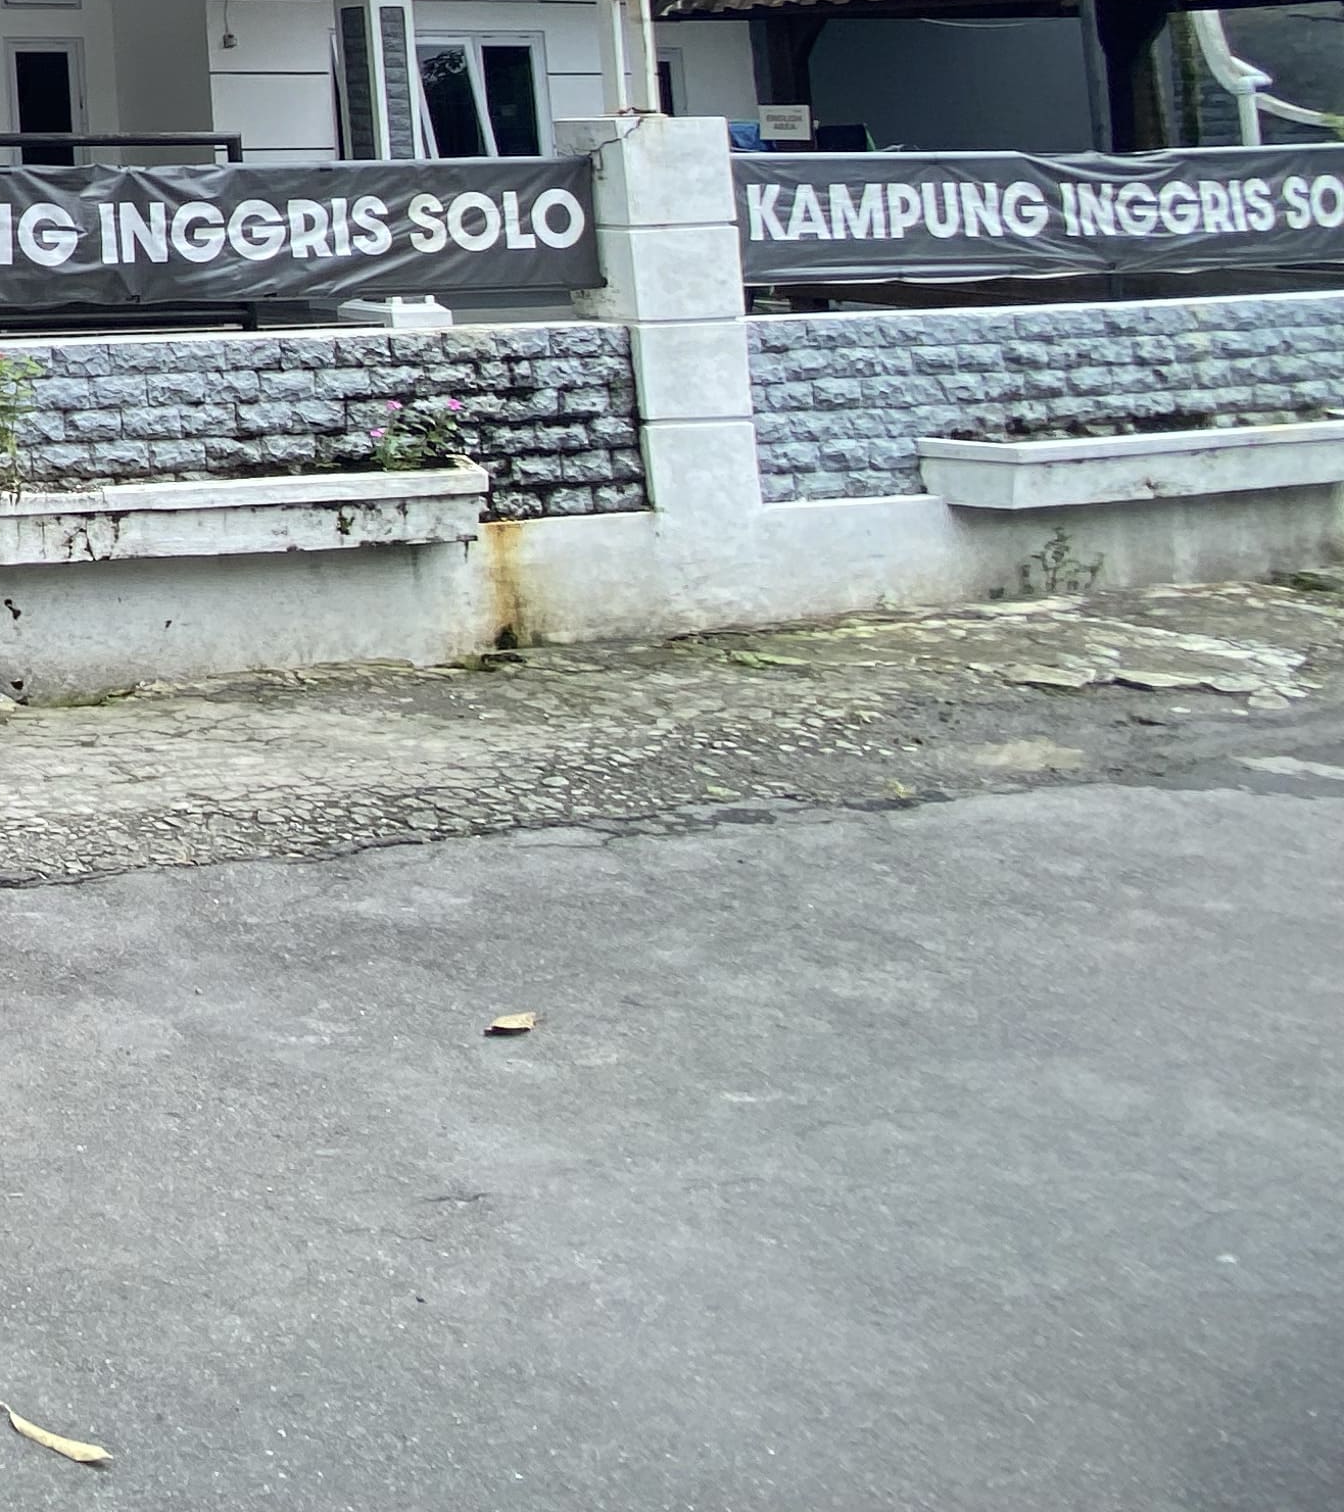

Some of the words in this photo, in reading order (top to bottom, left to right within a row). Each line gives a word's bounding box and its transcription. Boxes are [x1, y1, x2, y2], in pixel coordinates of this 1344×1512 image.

[97, 194, 393, 265] INGGRIS
[407, 188, 585, 253] SOLO
[747, 181, 1049, 241] KAMPUNG
[1057, 177, 1276, 238] INGGRIS
